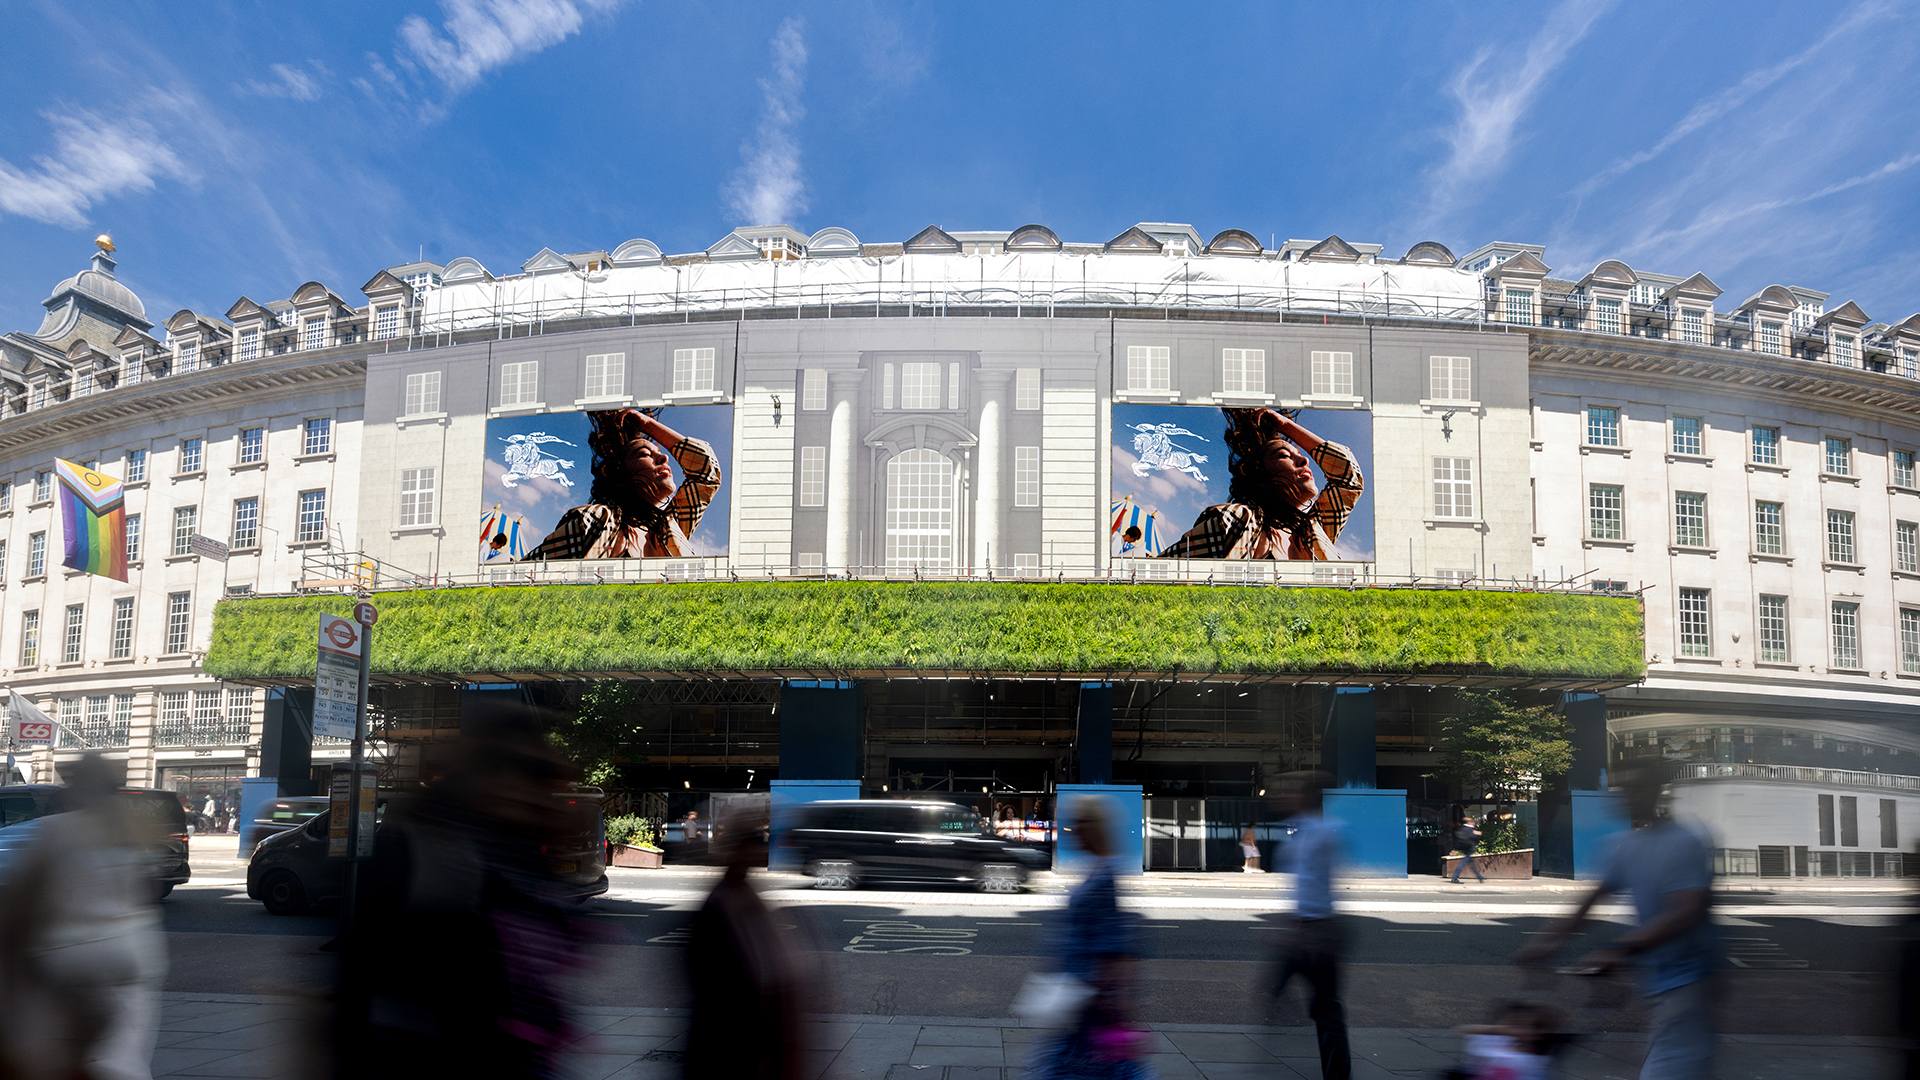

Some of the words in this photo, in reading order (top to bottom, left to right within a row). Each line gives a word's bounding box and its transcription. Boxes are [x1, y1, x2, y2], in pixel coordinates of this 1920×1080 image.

[361, 605, 373, 623] E
[324, 655, 344, 664] Piccadilly
[843, 922, 978, 955] STOP
